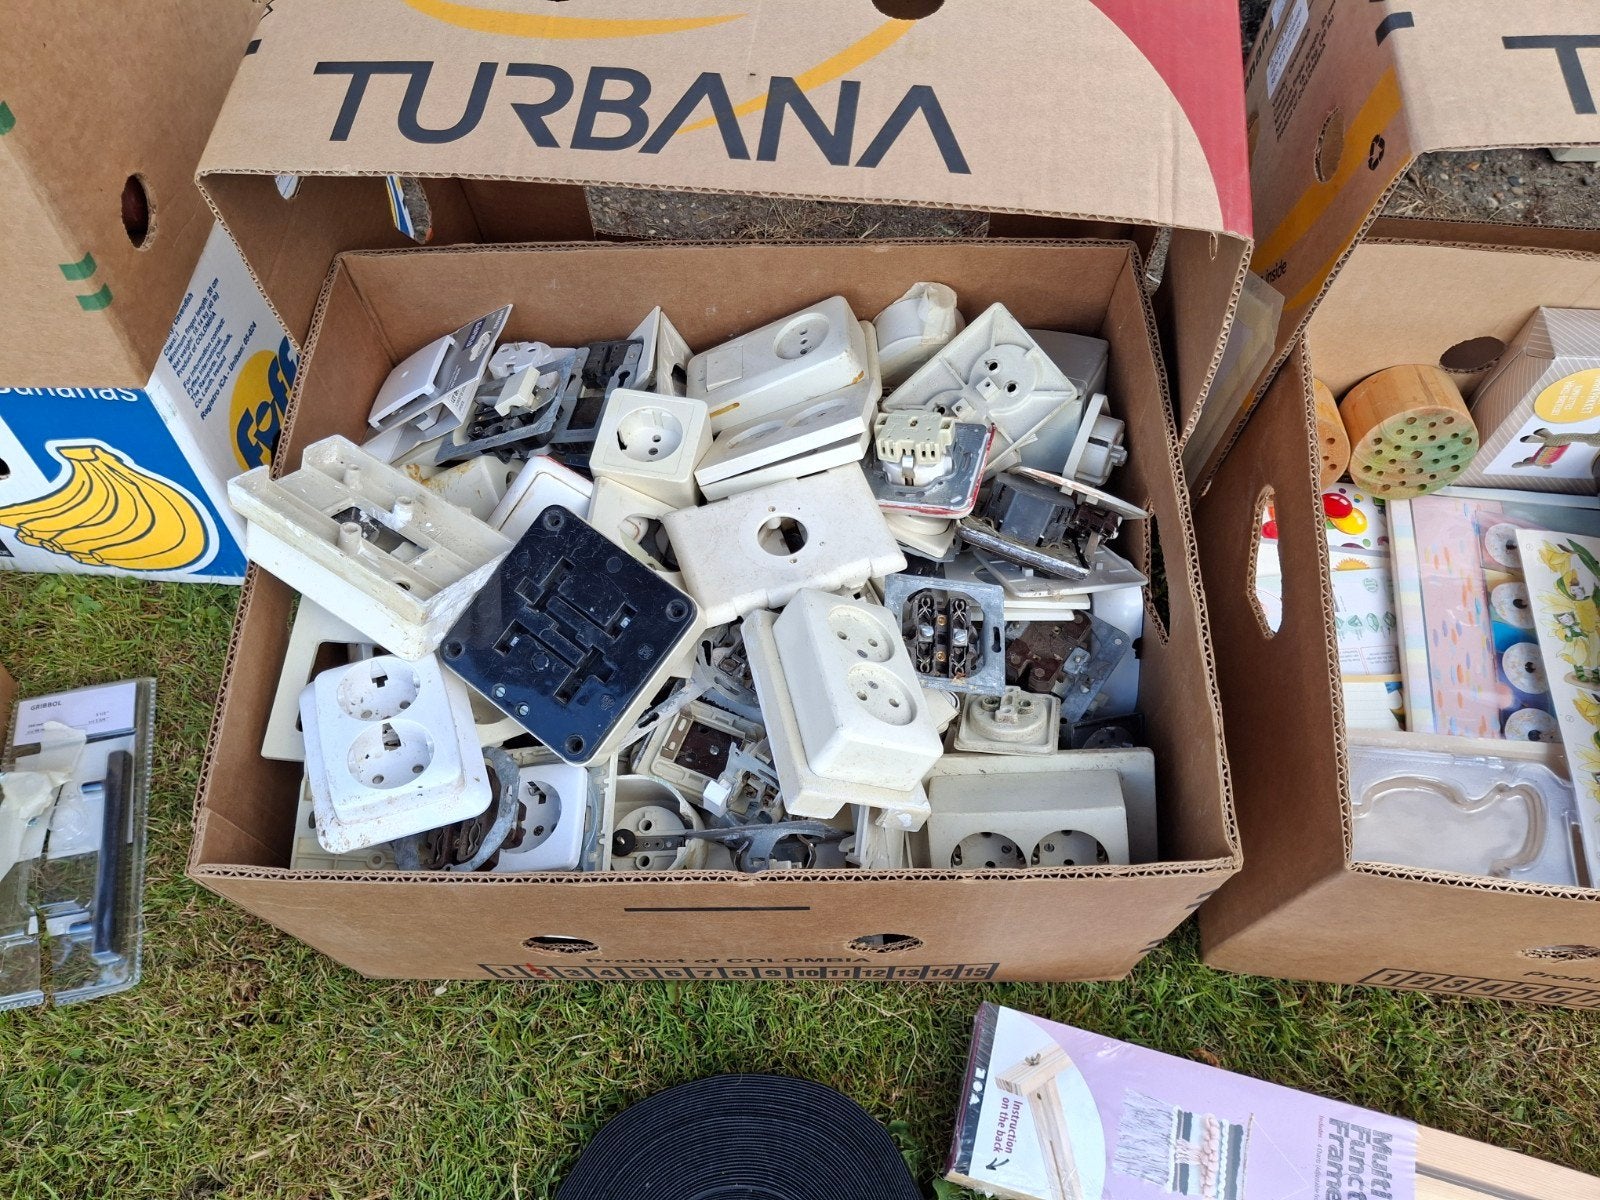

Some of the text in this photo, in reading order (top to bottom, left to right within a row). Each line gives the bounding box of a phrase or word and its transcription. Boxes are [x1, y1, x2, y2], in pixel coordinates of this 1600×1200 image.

[313, 61, 971, 174] TURBANA
[168, 334, 186, 365] Minimum
[185, 314, 198, 337] finger
[176, 311, 217, 378] Product of COLOMBIA
[172, 358, 180, 372] Net
[183, 376, 192, 389] For
[190, 342, 212, 380] information
[213, 355, 227, 378] Ireland
[0, 387, 139, 401] anas
[190, 388, 200, 402] The
[200, 389, 220, 421] Registro
[218, 374, 229, 391] ICA
[30, 700, 62, 711] GRIBBOL
[563, 968, 583, 977] 3
[599, 968, 617, 977] 4
[631, 968, 650, 977] 5
[664, 968, 682, 977] 6
[696, 968, 714, 977] 7
[731, 968, 749, 977] 8
[765, 968, 782, 977] 9
[795, 968, 819, 977] 10
[828, 968, 853, 977] 11
[862, 968, 888, 977] 12
[896, 968, 922, 977] 13
[930, 968, 954, 977] 14
[964, 968, 988, 977] 15
[1382, 973, 1402, 982] 1
[1410, 976, 1437, 986] 2
[1443, 979, 1470, 989] 3
[1478, 983, 1503, 993] 4
[1509, 987, 1537, 997] 5
[1543, 991, 1573, 999] 6
[993, 1097, 1010, 1153] on the back
[1004, 1100, 1023, 1154] Instruction
[1370, 1129, 1393, 1200] Multi
